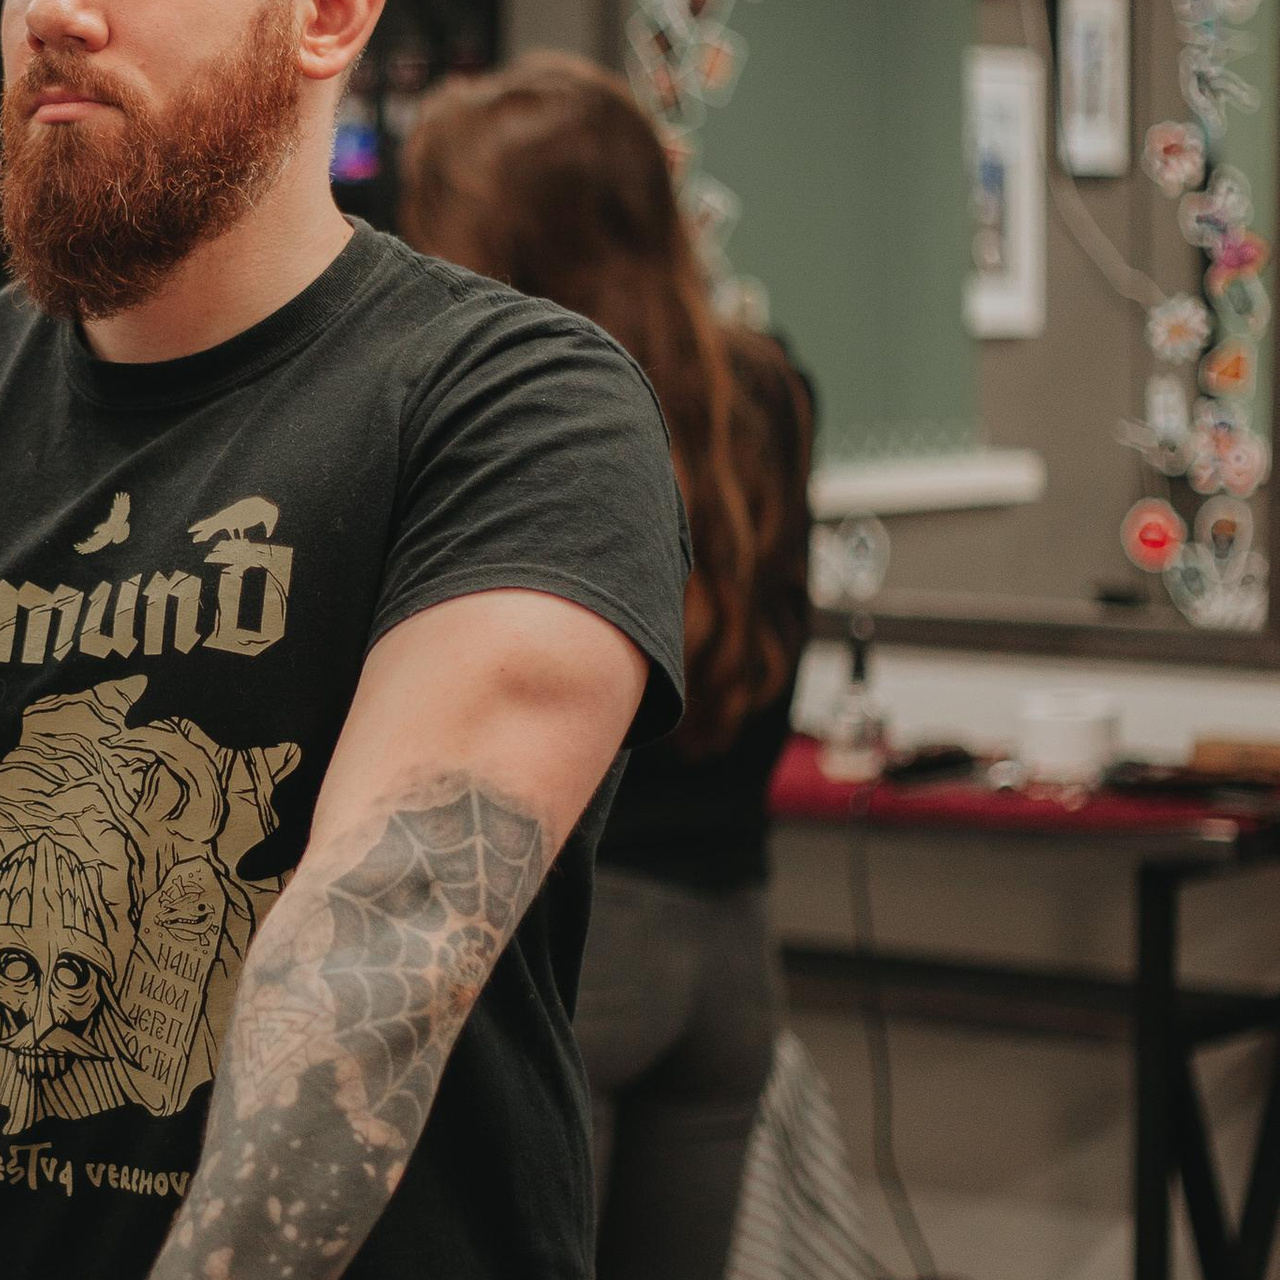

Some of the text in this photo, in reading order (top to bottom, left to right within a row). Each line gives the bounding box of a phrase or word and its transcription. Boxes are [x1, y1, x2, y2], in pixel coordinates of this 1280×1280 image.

[157, 942, 201, 983] НАШ
[139, 971, 189, 1013] ИДОЛ
[123, 1031, 175, 1085] ОСТИ
